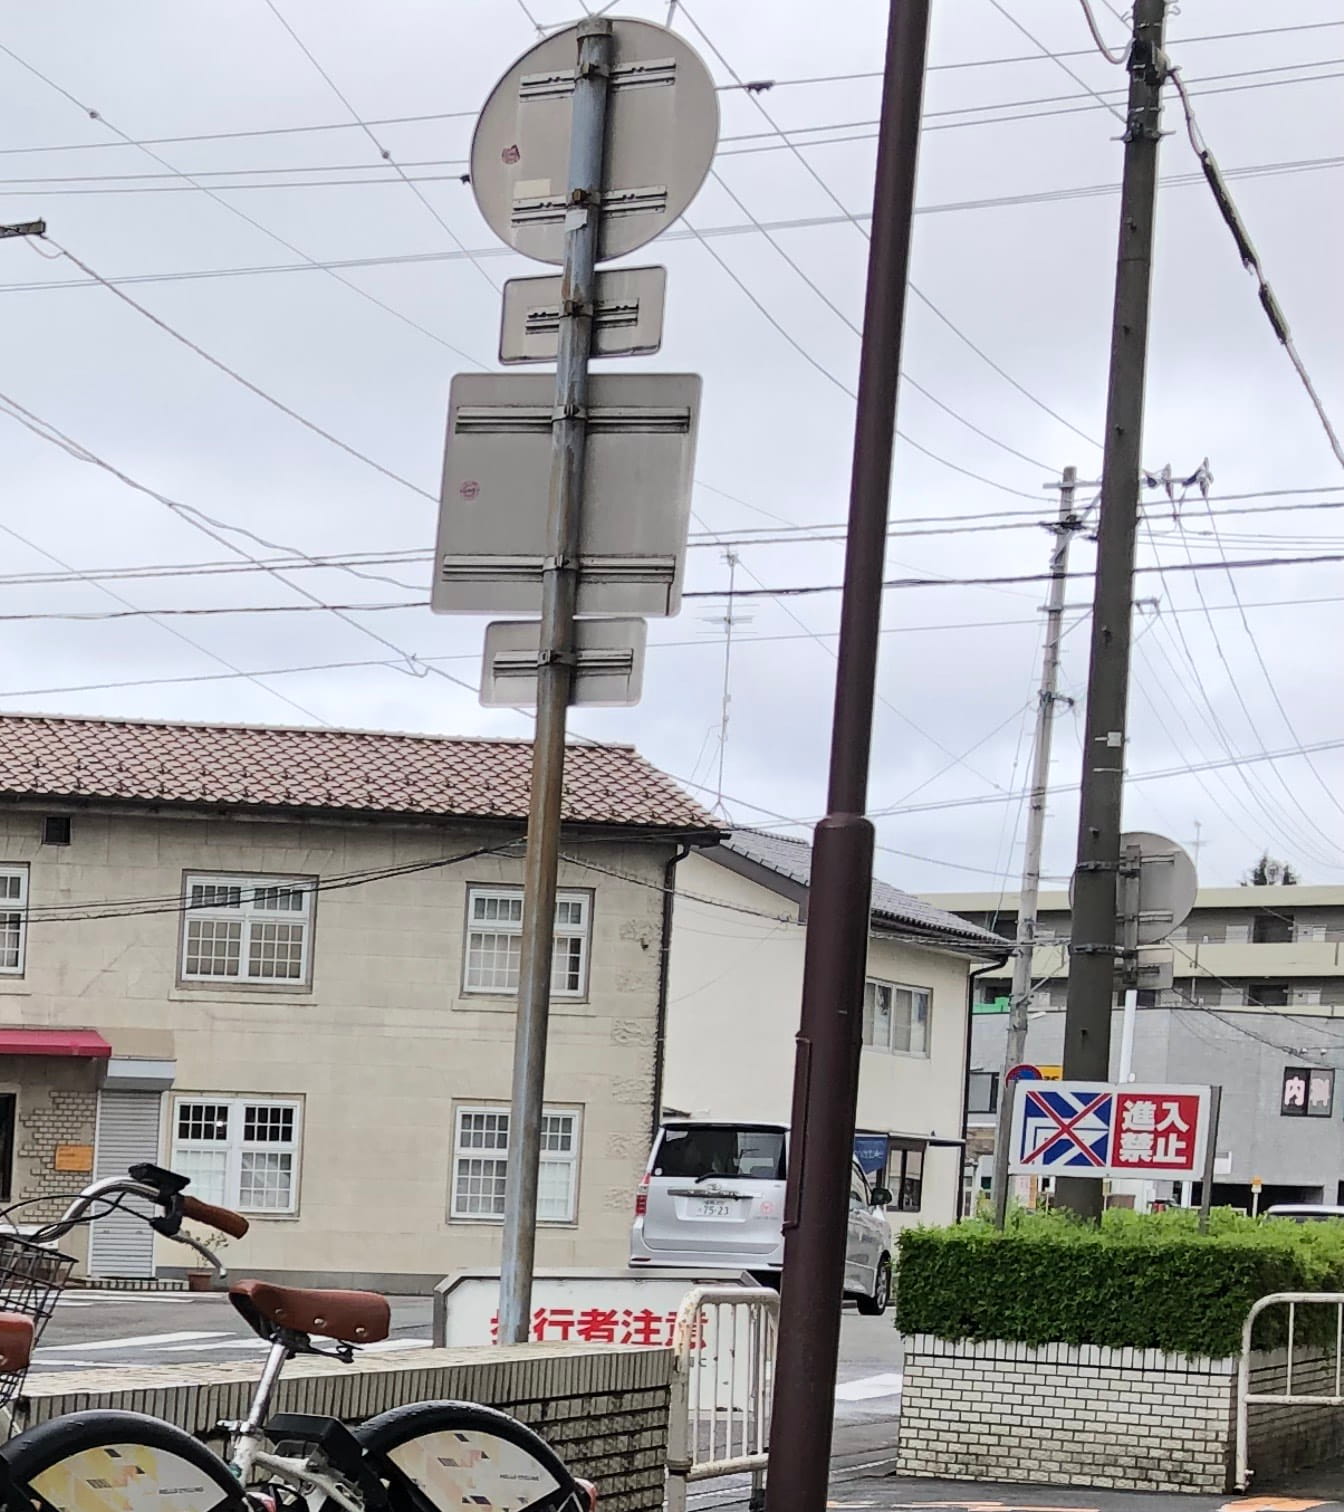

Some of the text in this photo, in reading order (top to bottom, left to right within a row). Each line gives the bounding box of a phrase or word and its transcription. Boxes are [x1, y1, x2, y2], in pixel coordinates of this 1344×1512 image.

[1122, 1100, 1190, 1133] 進入
[1119, 1132, 1187, 1164] 禁止
[490, 1307, 709, 1350] 行者注意
